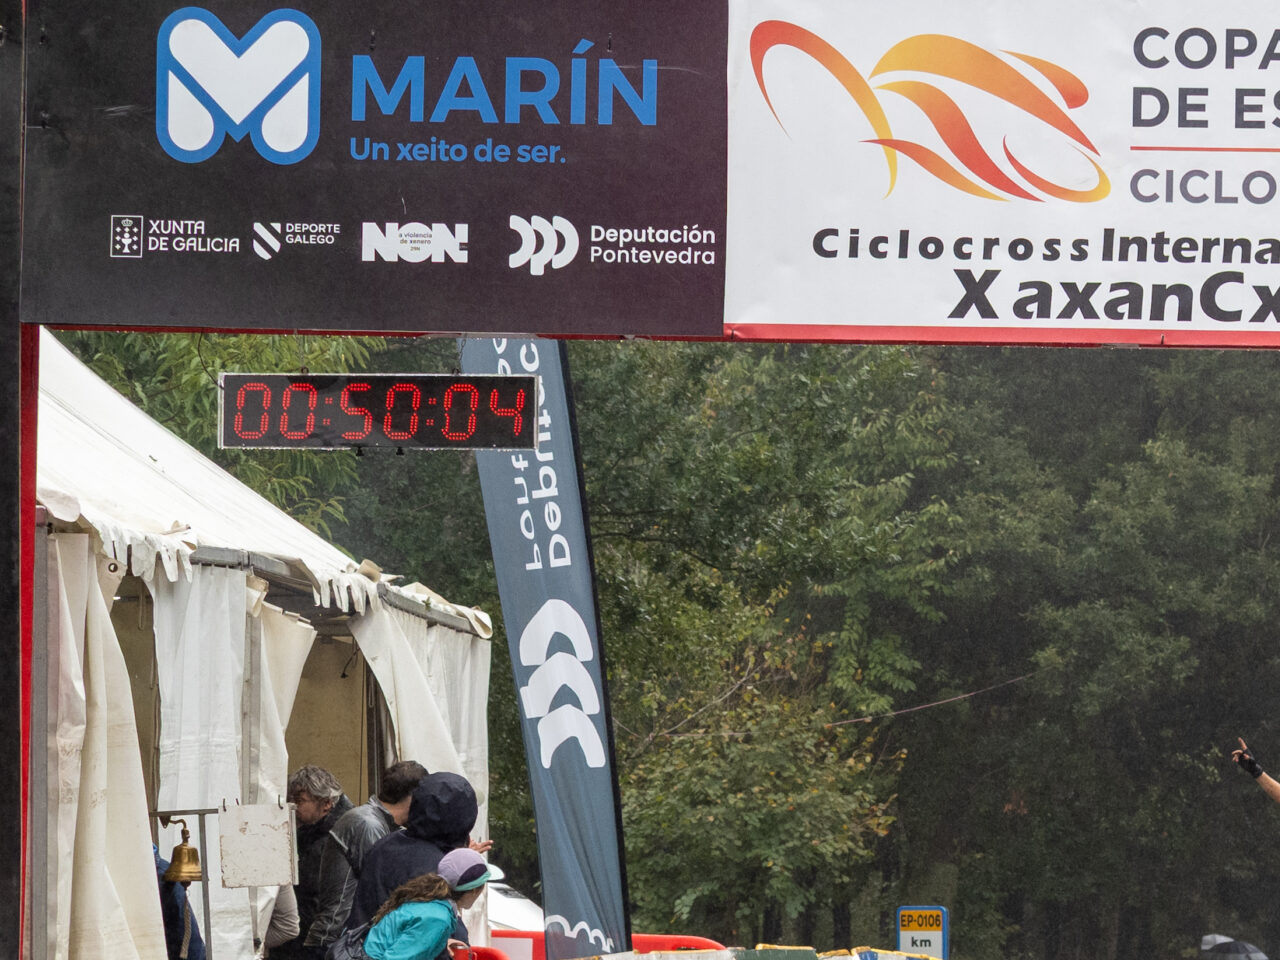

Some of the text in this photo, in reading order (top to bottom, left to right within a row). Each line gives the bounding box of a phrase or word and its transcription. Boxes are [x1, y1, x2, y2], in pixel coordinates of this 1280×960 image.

[351, 38, 659, 126] MARÍN
[1132, 87, 1209, 128] DE
[350, 138, 567, 164] Un xeito de ser.
[149, 220, 205, 234] XUNTA
[286, 223, 341, 233] DEPORTE
[590, 224, 716, 247] Deputación
[149, 237, 240, 252] DE GALICIA
[285, 234, 335, 245] GALEGO
[812, 228, 1090, 261] Ciclocross
[590, 247, 716, 265] Pontevedra
[233, 381, 527, 440] 00:50:04
[900, 914, 942, 928] EP-0106
[911, 936, 931, 947] km
